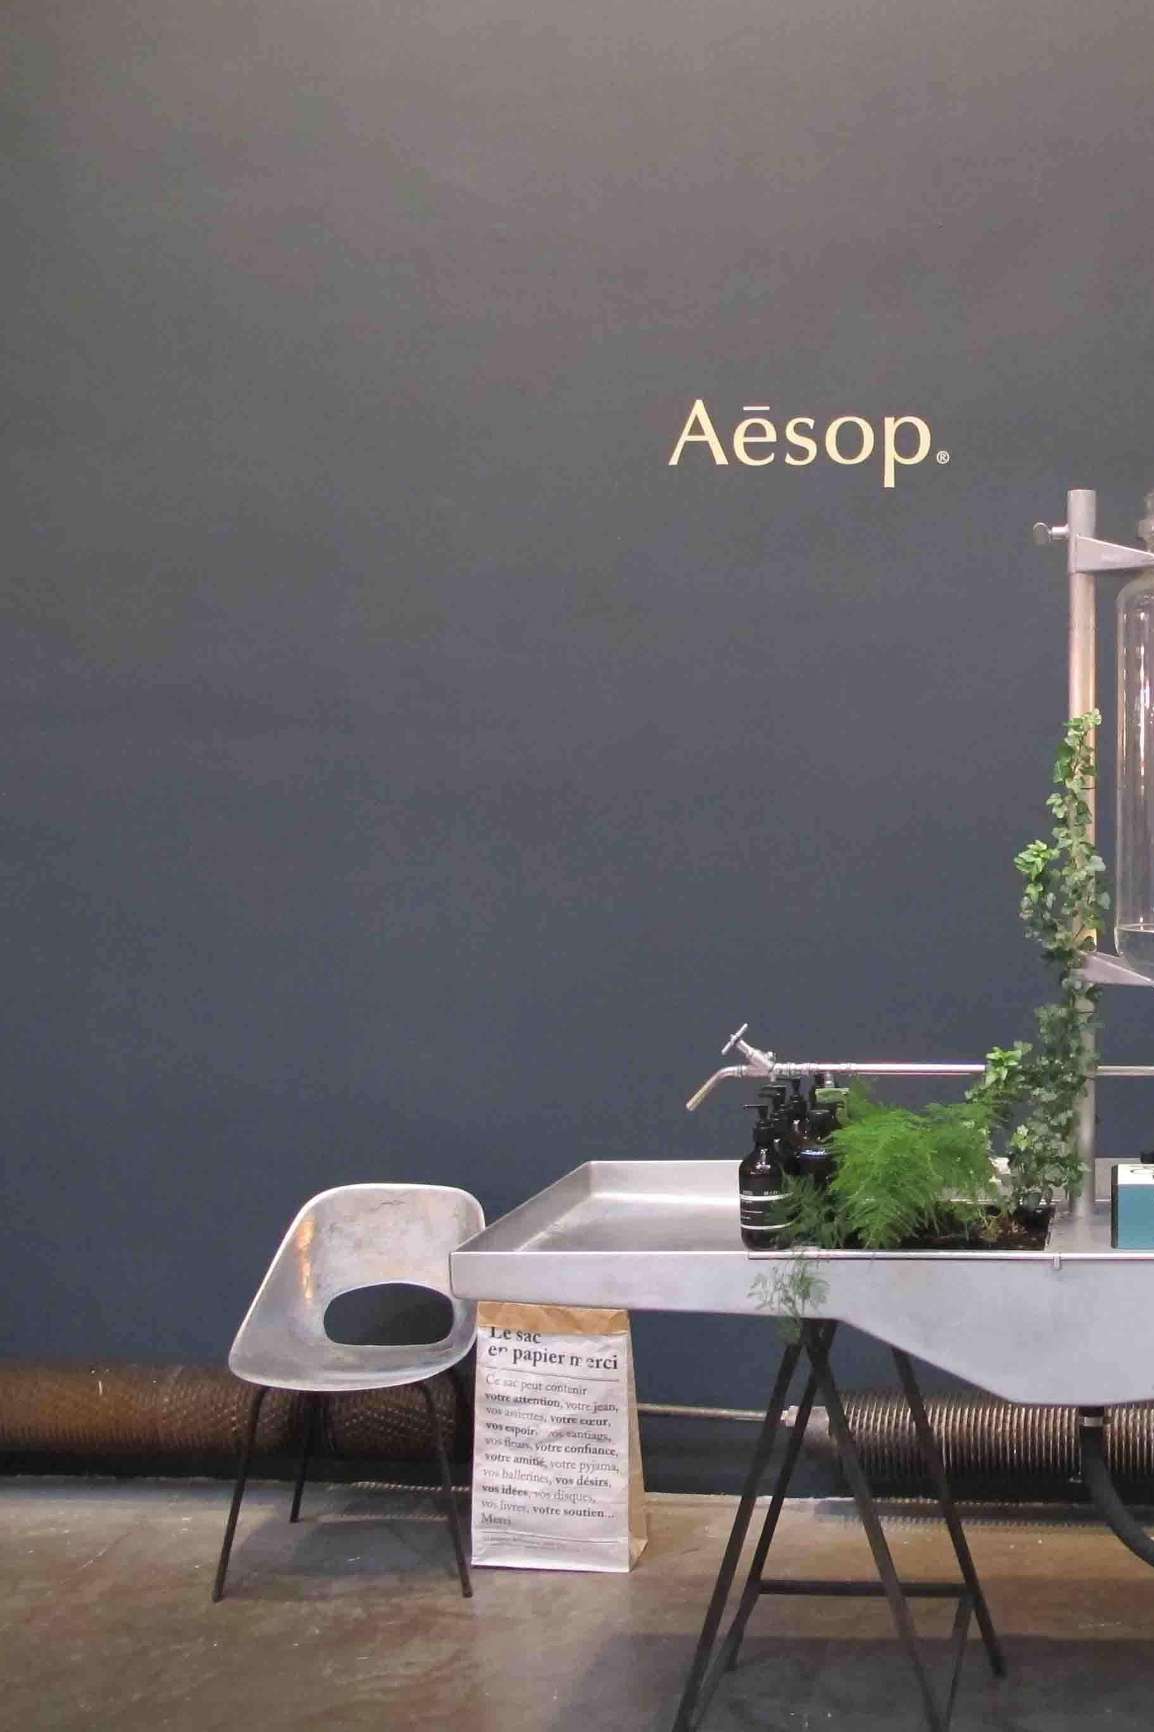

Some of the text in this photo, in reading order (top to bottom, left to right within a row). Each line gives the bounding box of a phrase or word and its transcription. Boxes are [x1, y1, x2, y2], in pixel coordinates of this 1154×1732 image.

[515, 1329, 542, 1344] sac
[512, 1347, 566, 1367] papier
[521, 1380, 543, 1392] peut
[545, 1383, 588, 1396] contenir
[484, 1392, 511, 1402] votre
[513, 1394, 563, 1408] attention,
[566, 1401, 591, 1412] votre
[486, 1421, 503, 1431] vos
[550, 1414, 577, 1425] votre
[535, 1442, 562, 1453] votre
[564, 1443, 619, 1457] confiance,
[484, 1452, 511, 1463] votre
[550, 1459, 577, 1470] votre
[481, 1484, 500, 1493] vos
[555, 1475, 574, 1485] vos
[576, 1475, 612, 1488] désirs,
[532, 1504, 560, 1516] votre
